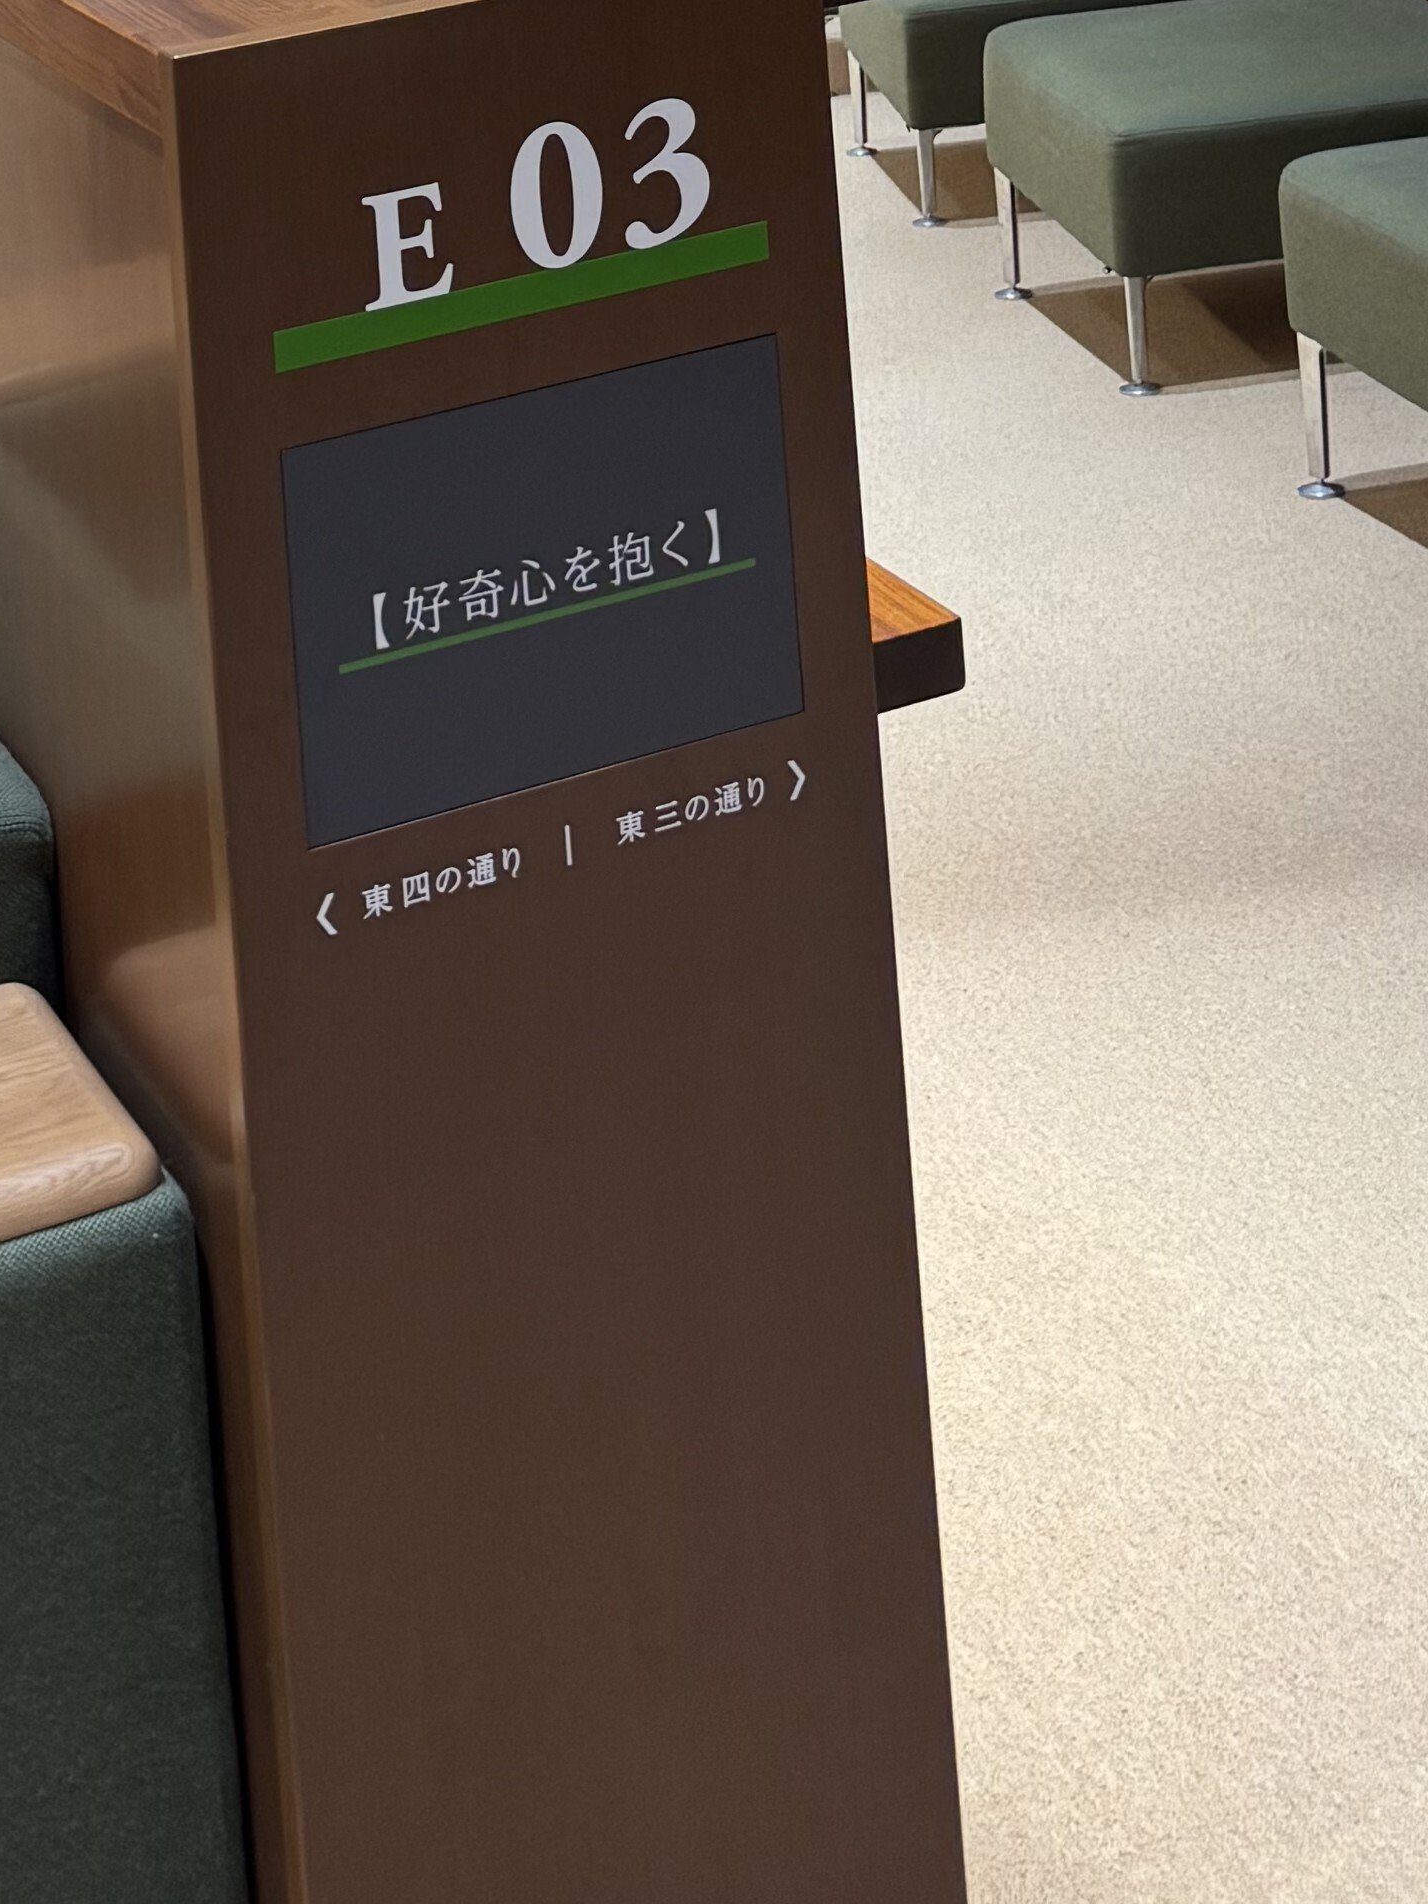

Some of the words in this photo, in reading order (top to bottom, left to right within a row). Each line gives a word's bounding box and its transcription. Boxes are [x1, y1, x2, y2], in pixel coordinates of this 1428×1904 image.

[361, 182, 454, 312] E
[510, 98, 711, 269] 03
[372, 508, 722, 650] 【好奇心を抱く】
[362, 847, 522, 920] 東四の通り
[615, 777, 767, 845] 東三の通り
